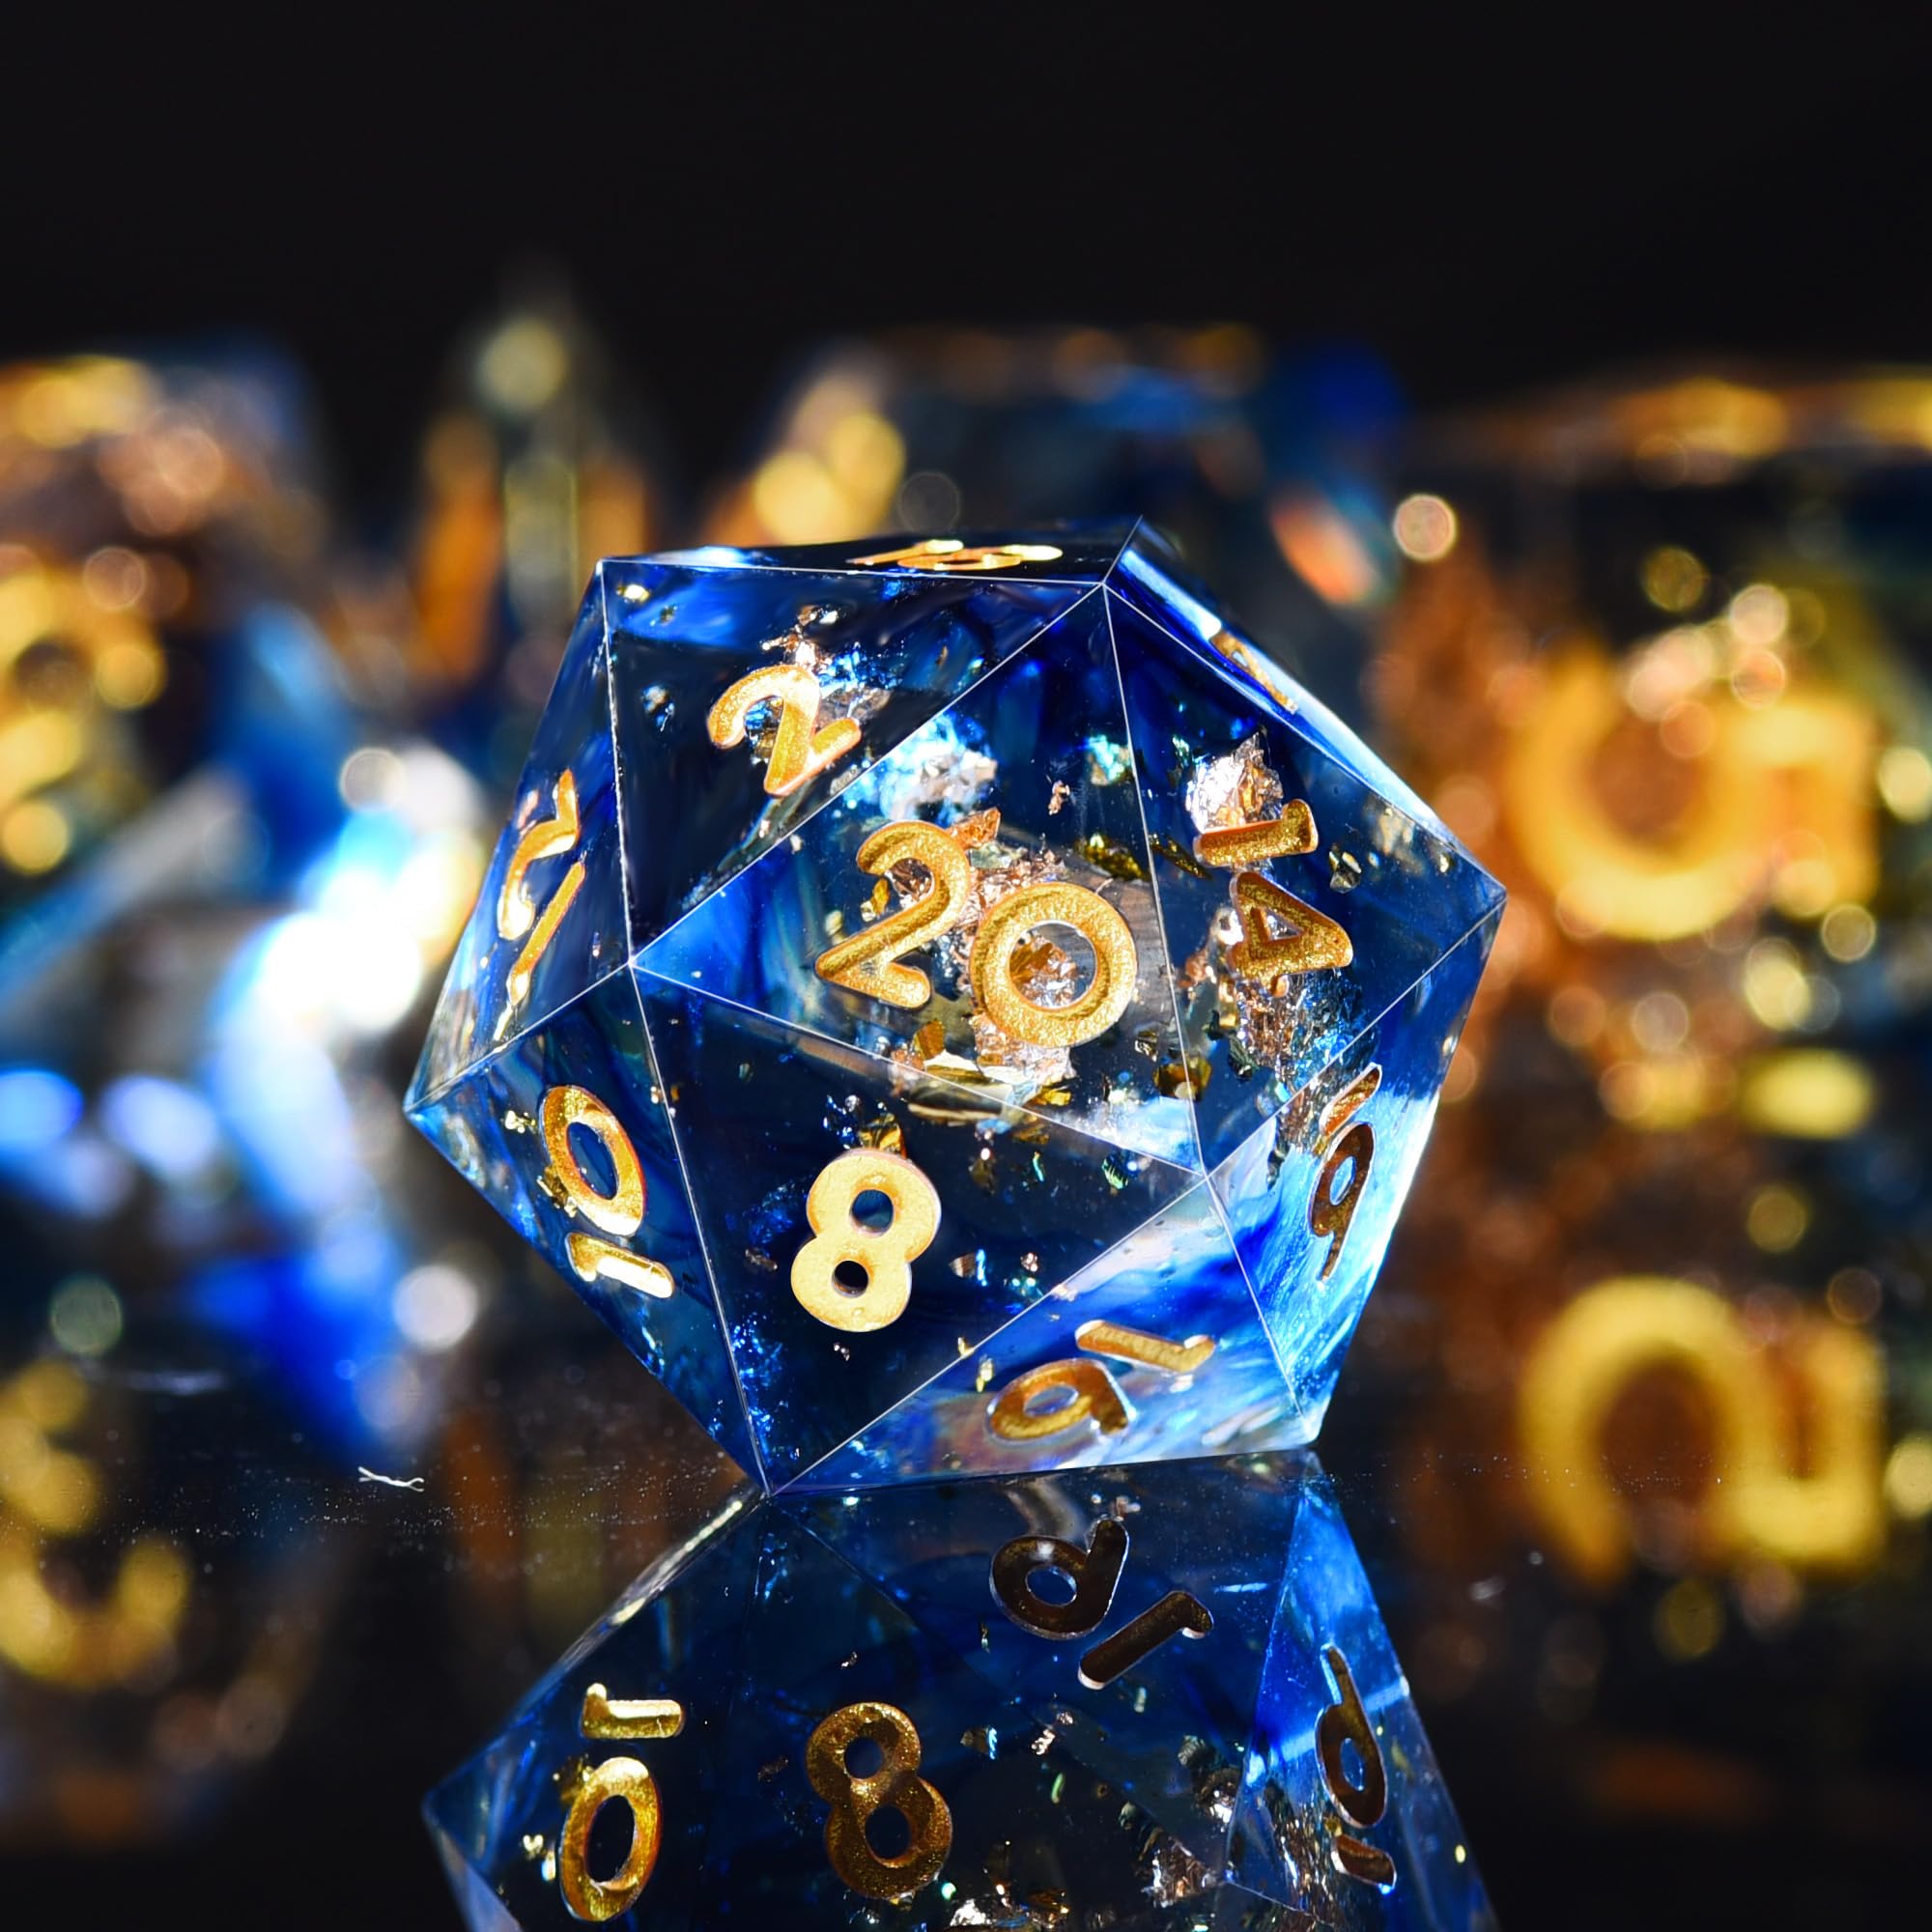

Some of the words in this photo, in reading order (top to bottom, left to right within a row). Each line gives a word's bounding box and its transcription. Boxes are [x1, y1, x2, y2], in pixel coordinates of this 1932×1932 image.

[707, 665, 862, 796] 2
[815, 820, 1138, 1047] 20
[1193, 799, 1353, 997] 14
[538, 1085, 674, 1298] 10
[790, 1148, 942, 1333] 8
